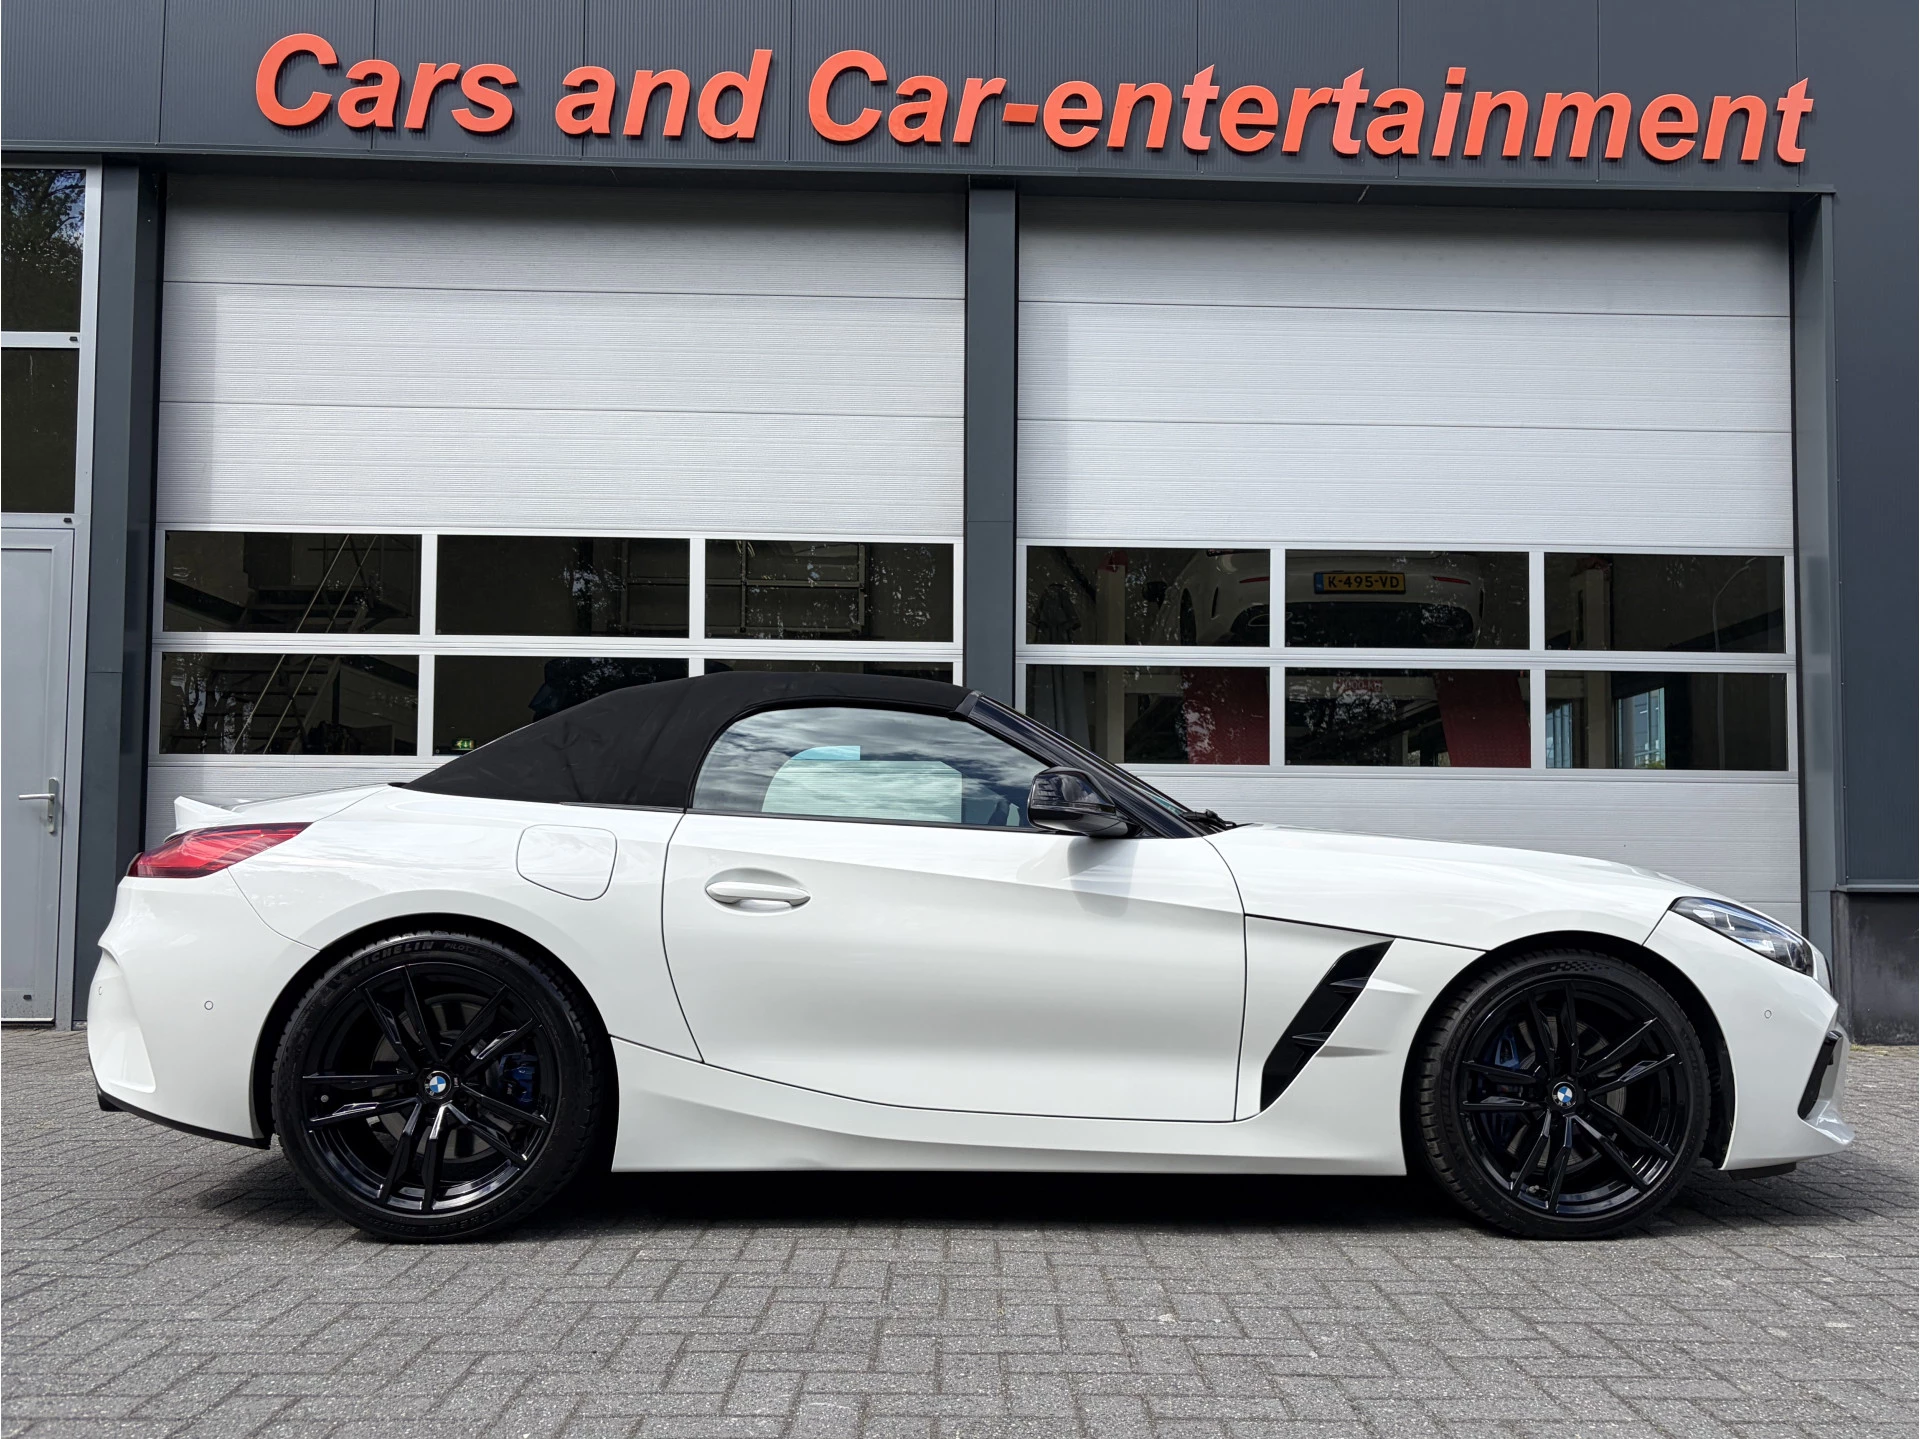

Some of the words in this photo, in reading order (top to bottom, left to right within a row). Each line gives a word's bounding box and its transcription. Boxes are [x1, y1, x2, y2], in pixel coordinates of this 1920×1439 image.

[255, 33, 518, 132] Cars
[555, 49, 773, 140] and
[808, 49, 1814, 163] Car-entertainment
[1327, 575, 1400, 589] K-495-VD
[350, 941, 435, 974] MICHELIN
